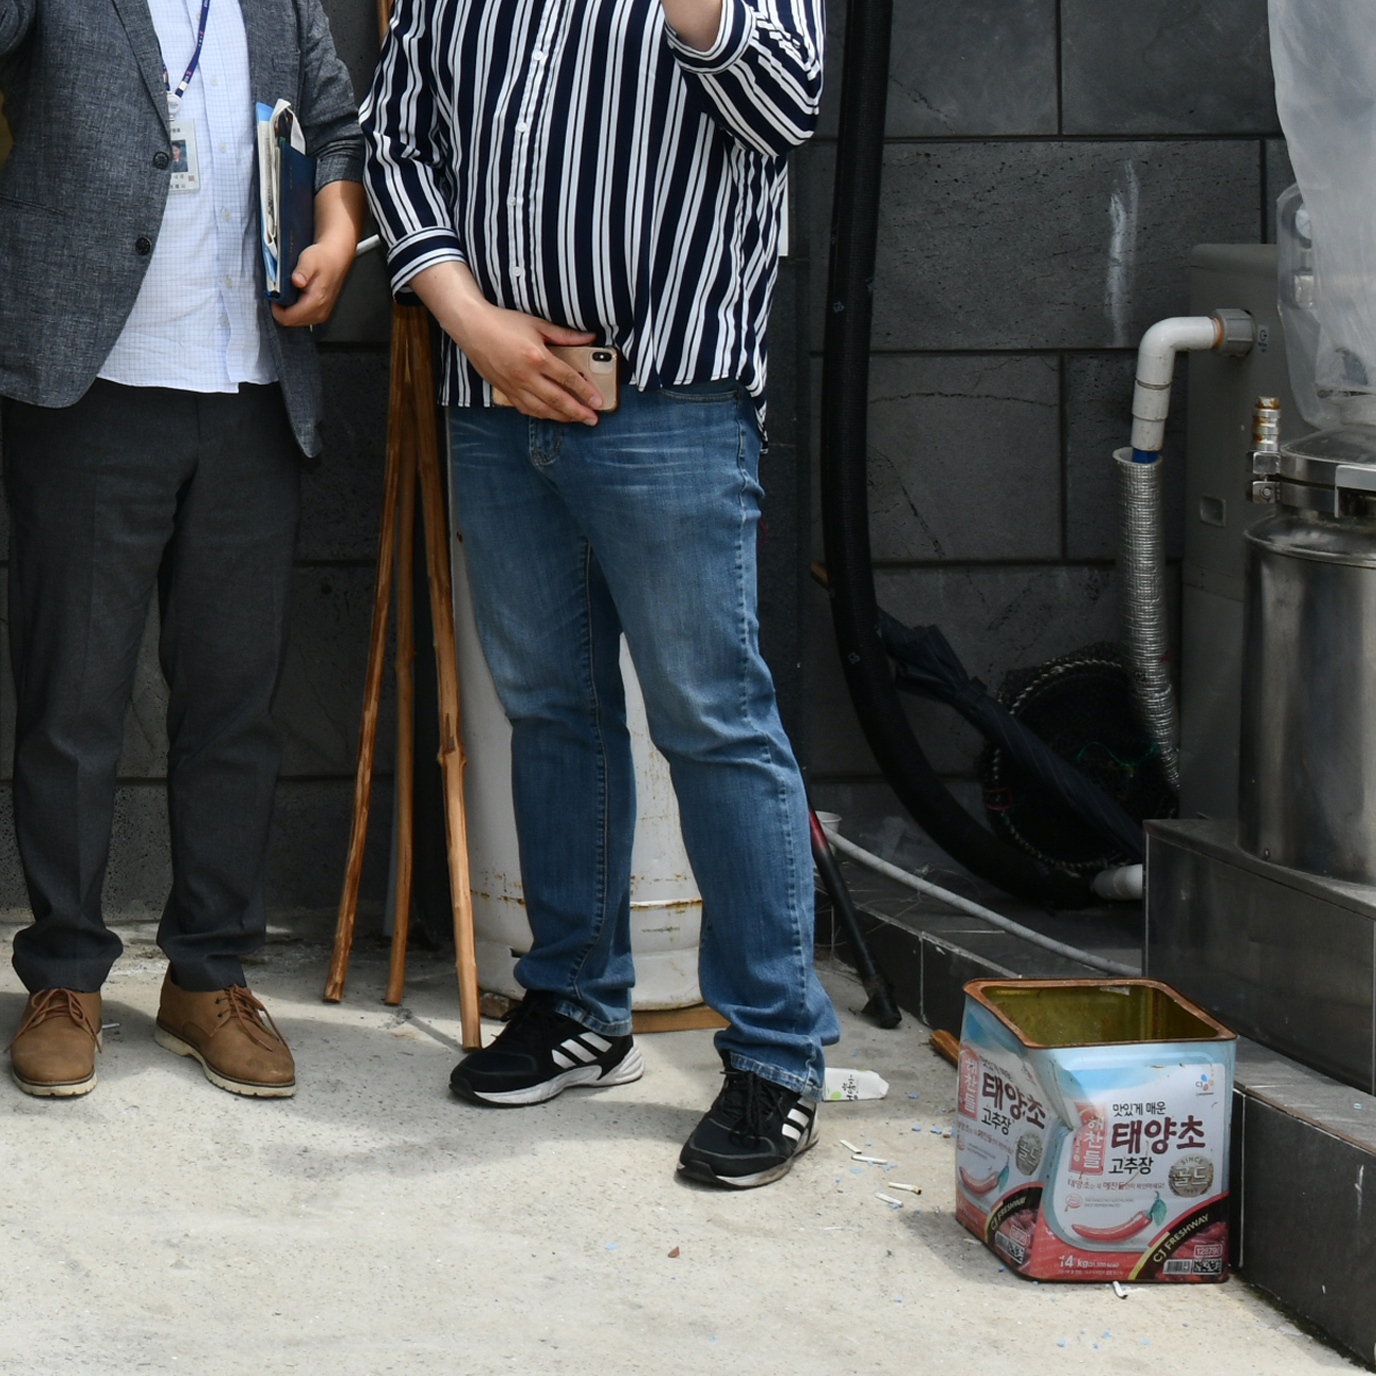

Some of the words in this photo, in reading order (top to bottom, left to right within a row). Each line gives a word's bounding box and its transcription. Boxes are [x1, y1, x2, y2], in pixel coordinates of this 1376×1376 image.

[981, 1072, 1046, 1130] 태양초
[1112, 1102, 1143, 1117] 맛있게
[1145, 1101, 1167, 1116] 매운
[981, 1107, 1012, 1146] 고추장
[1111, 1115, 1206, 1155] 태양초
[1108, 1156, 1154, 1175] 고추장
[1152, 1248, 1167, 1263] CJ
[1163, 1213, 1209, 1251] FRESHWAY
